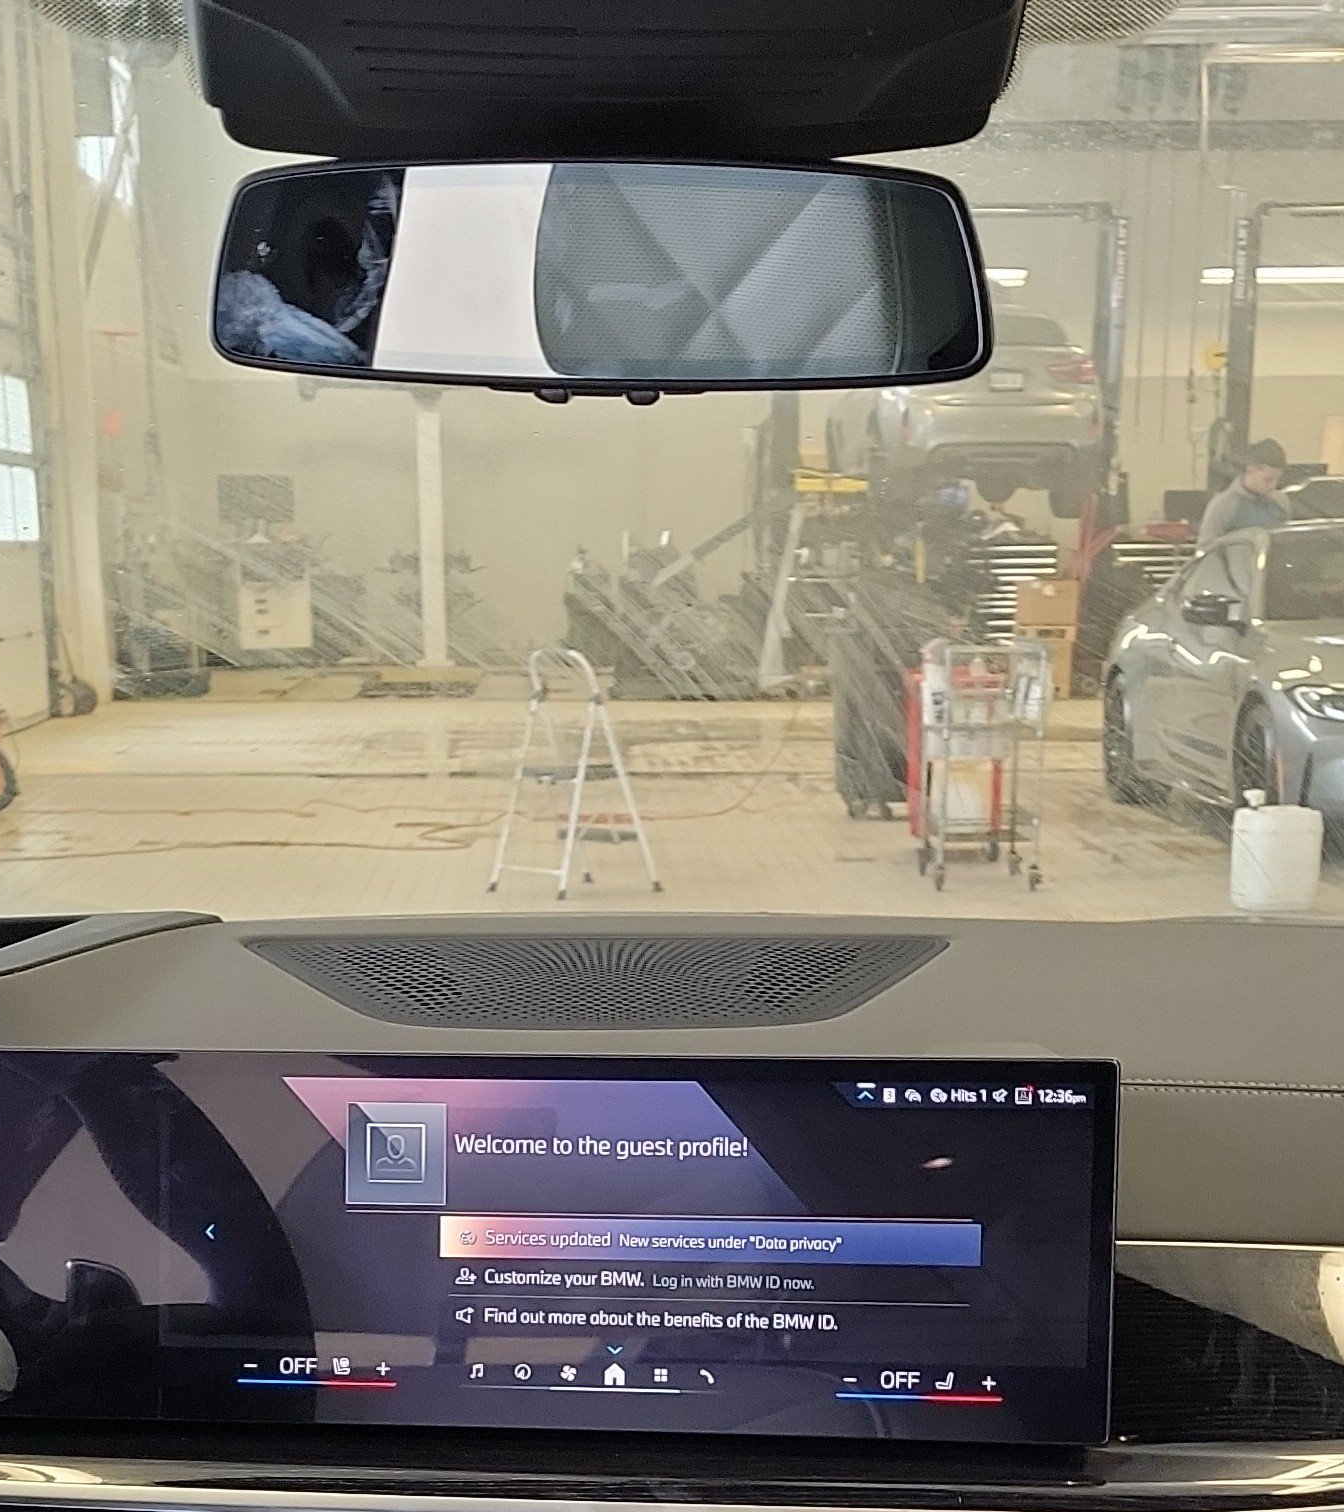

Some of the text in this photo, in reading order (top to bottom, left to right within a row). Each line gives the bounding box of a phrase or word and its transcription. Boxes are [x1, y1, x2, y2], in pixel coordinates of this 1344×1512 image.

[950, 1088, 977, 1103] Hits
[1037, 1089, 1087, 1105] 12:36pm
[454, 1134, 748, 1161] Welcome to the guest profile!
[485, 1229, 611, 1249] Services updated
[619, 1234, 842, 1252] New services under "Data privacy"
[484, 1268, 645, 1288] Customize your BMW.
[652, 1274, 815, 1290] Log in with BMW ID now.
[484, 1307, 838, 1331] Find out more about the benefits of the BMW ID.
[279, 1357, 318, 1375] OFF
[880, 1370, 921, 1389] OFF
